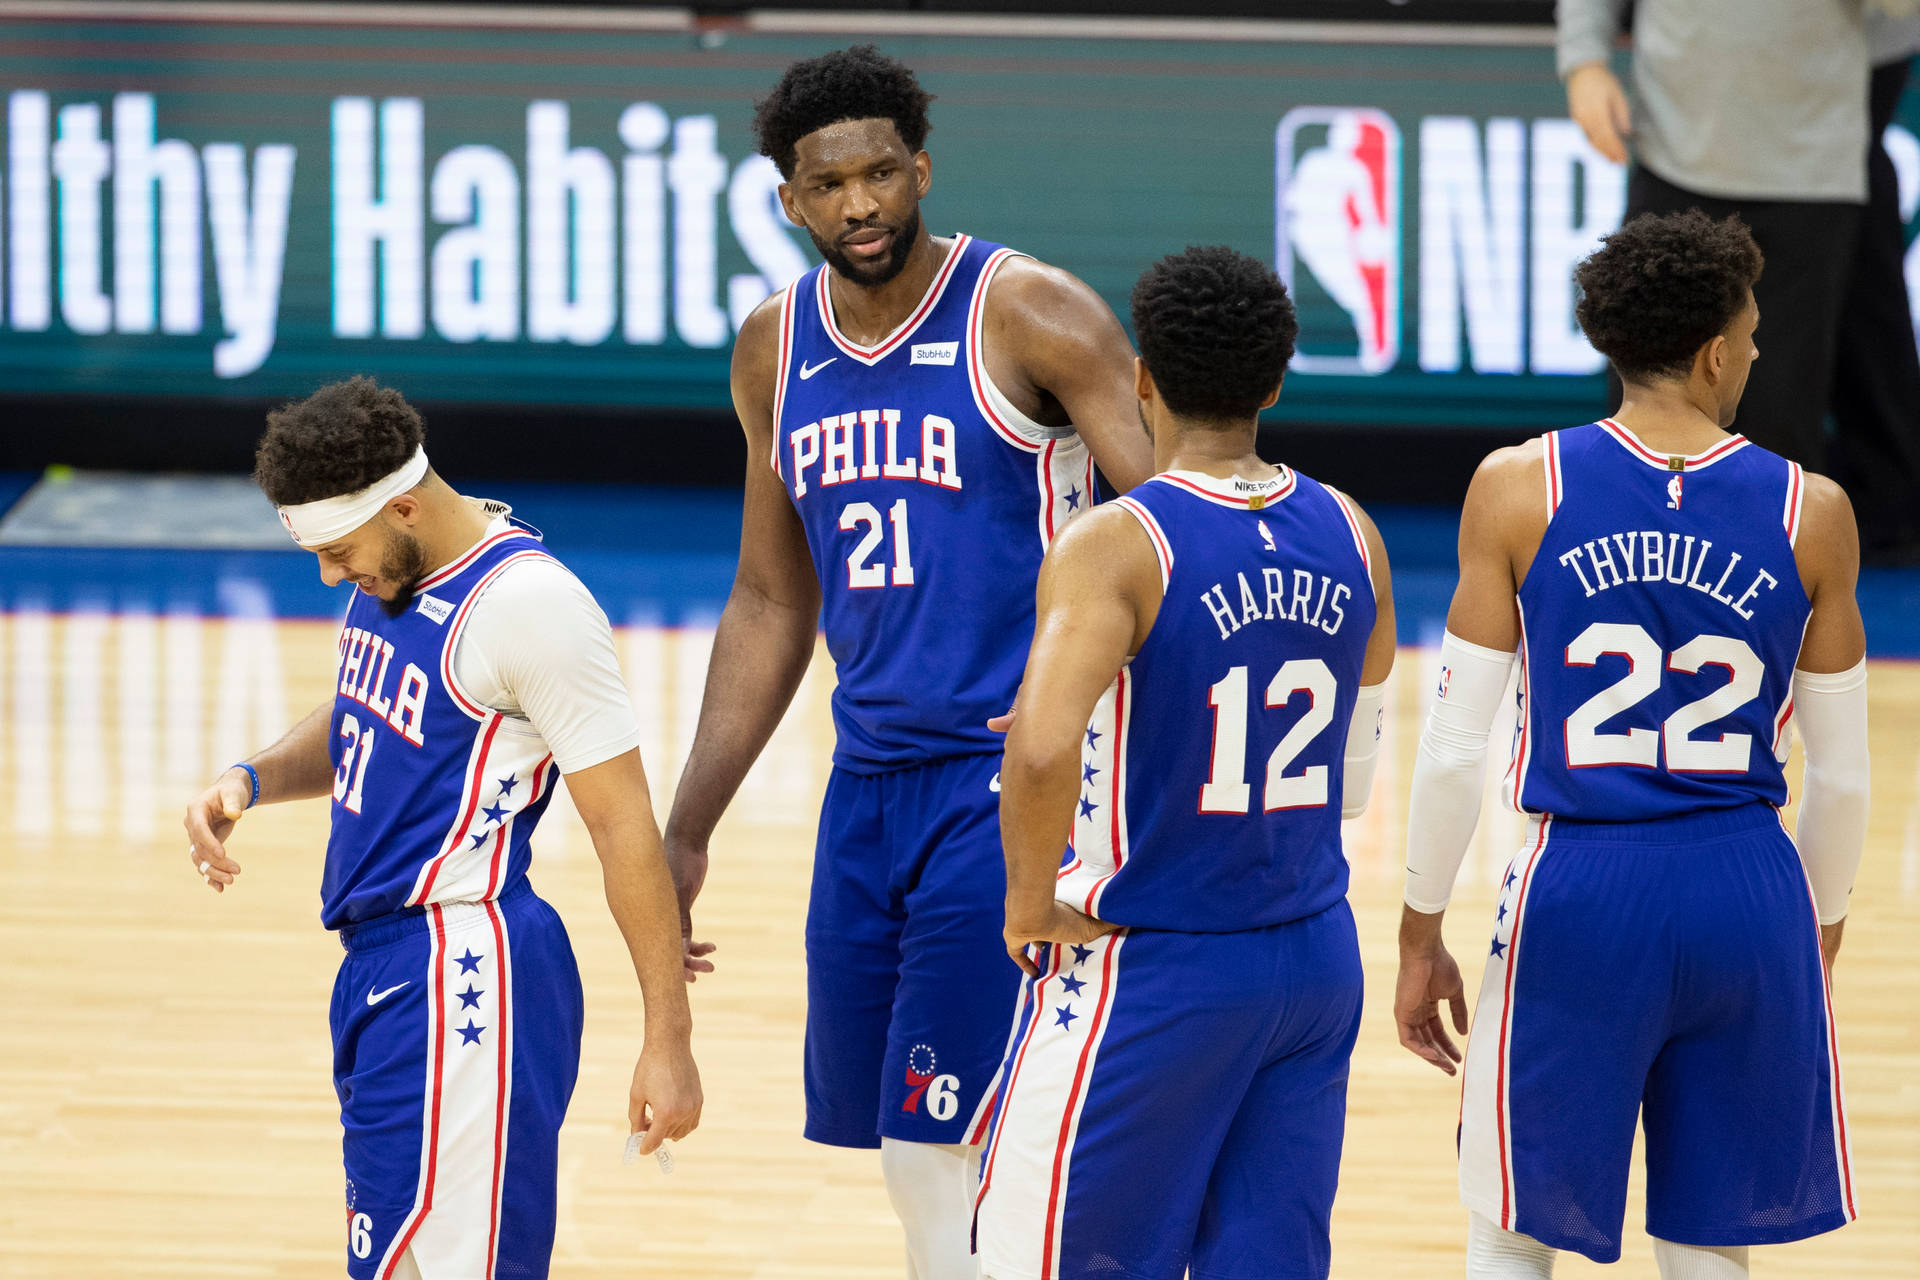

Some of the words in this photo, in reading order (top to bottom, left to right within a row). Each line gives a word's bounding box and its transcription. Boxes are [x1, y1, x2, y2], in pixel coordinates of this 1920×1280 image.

[0, 90, 295, 377] lthy
[1418, 115, 1629, 376] NB
[916, 349, 952, 359] StubHub
[790, 408, 962, 500] PHILA
[1234, 481, 1258, 492] NIKE
[838, 498, 915, 589] 21
[1558, 530, 1778, 621] THYBULLE
[1200, 567, 1352, 641] HARRIS
[1197, 658, 1338, 815] 12
[1564, 622, 1766, 774] 22
[332, 712, 375, 815] 31
[902, 1066, 960, 1121] 76
[346, 1208, 373, 1259] 6
